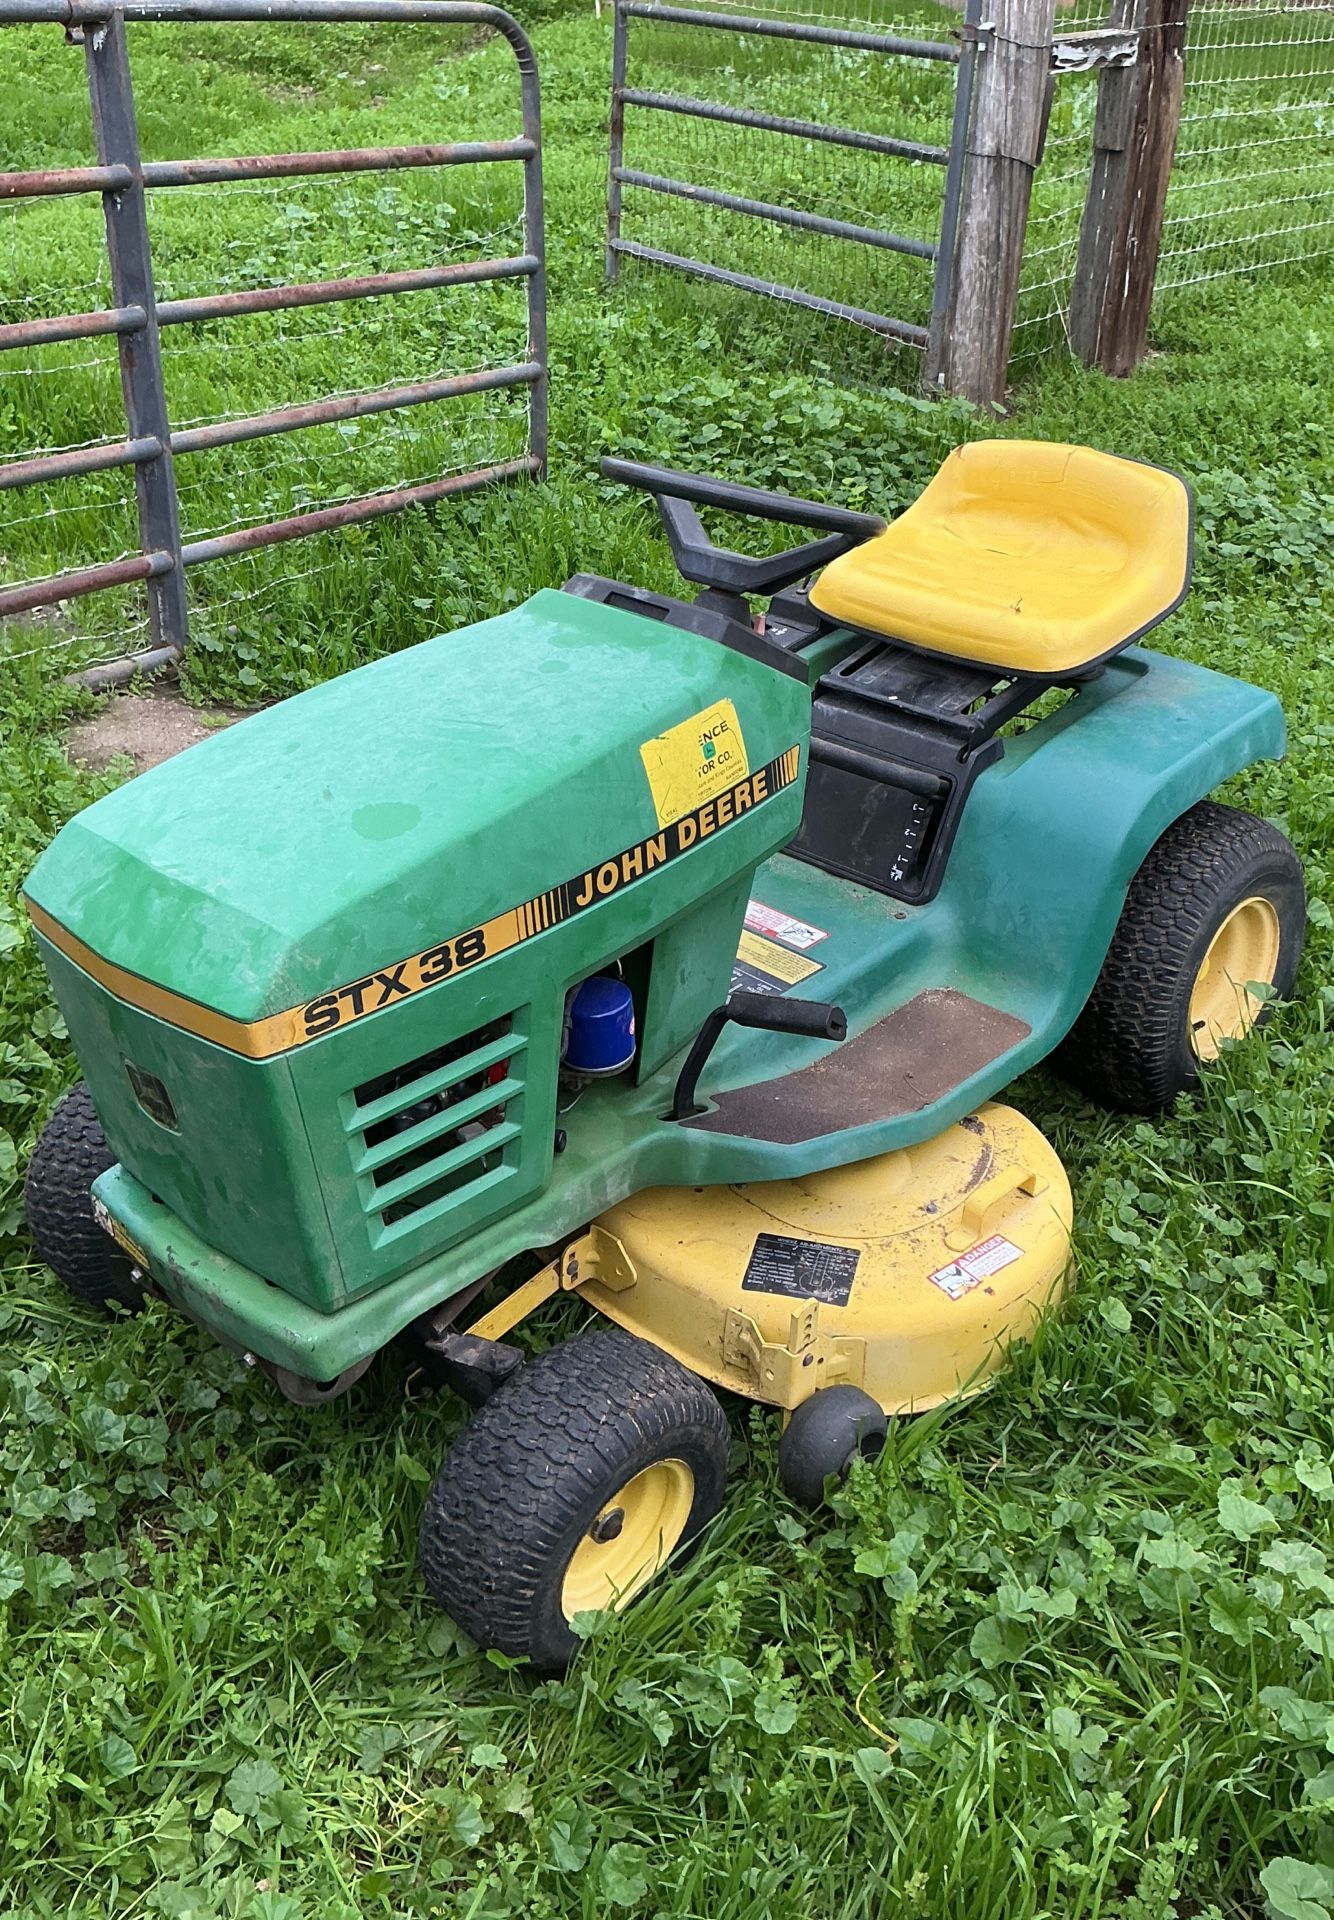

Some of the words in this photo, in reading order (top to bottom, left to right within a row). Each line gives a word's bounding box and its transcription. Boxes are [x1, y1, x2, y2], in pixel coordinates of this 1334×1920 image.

[717, 750, 733, 765] CO.
[576, 833, 667, 906] JOHN
[677, 770, 769, 850] DEERE
[304, 962, 412, 1036] STX
[419, 929, 487, 984] 38
[964, 1236, 1006, 1262] DANGER
